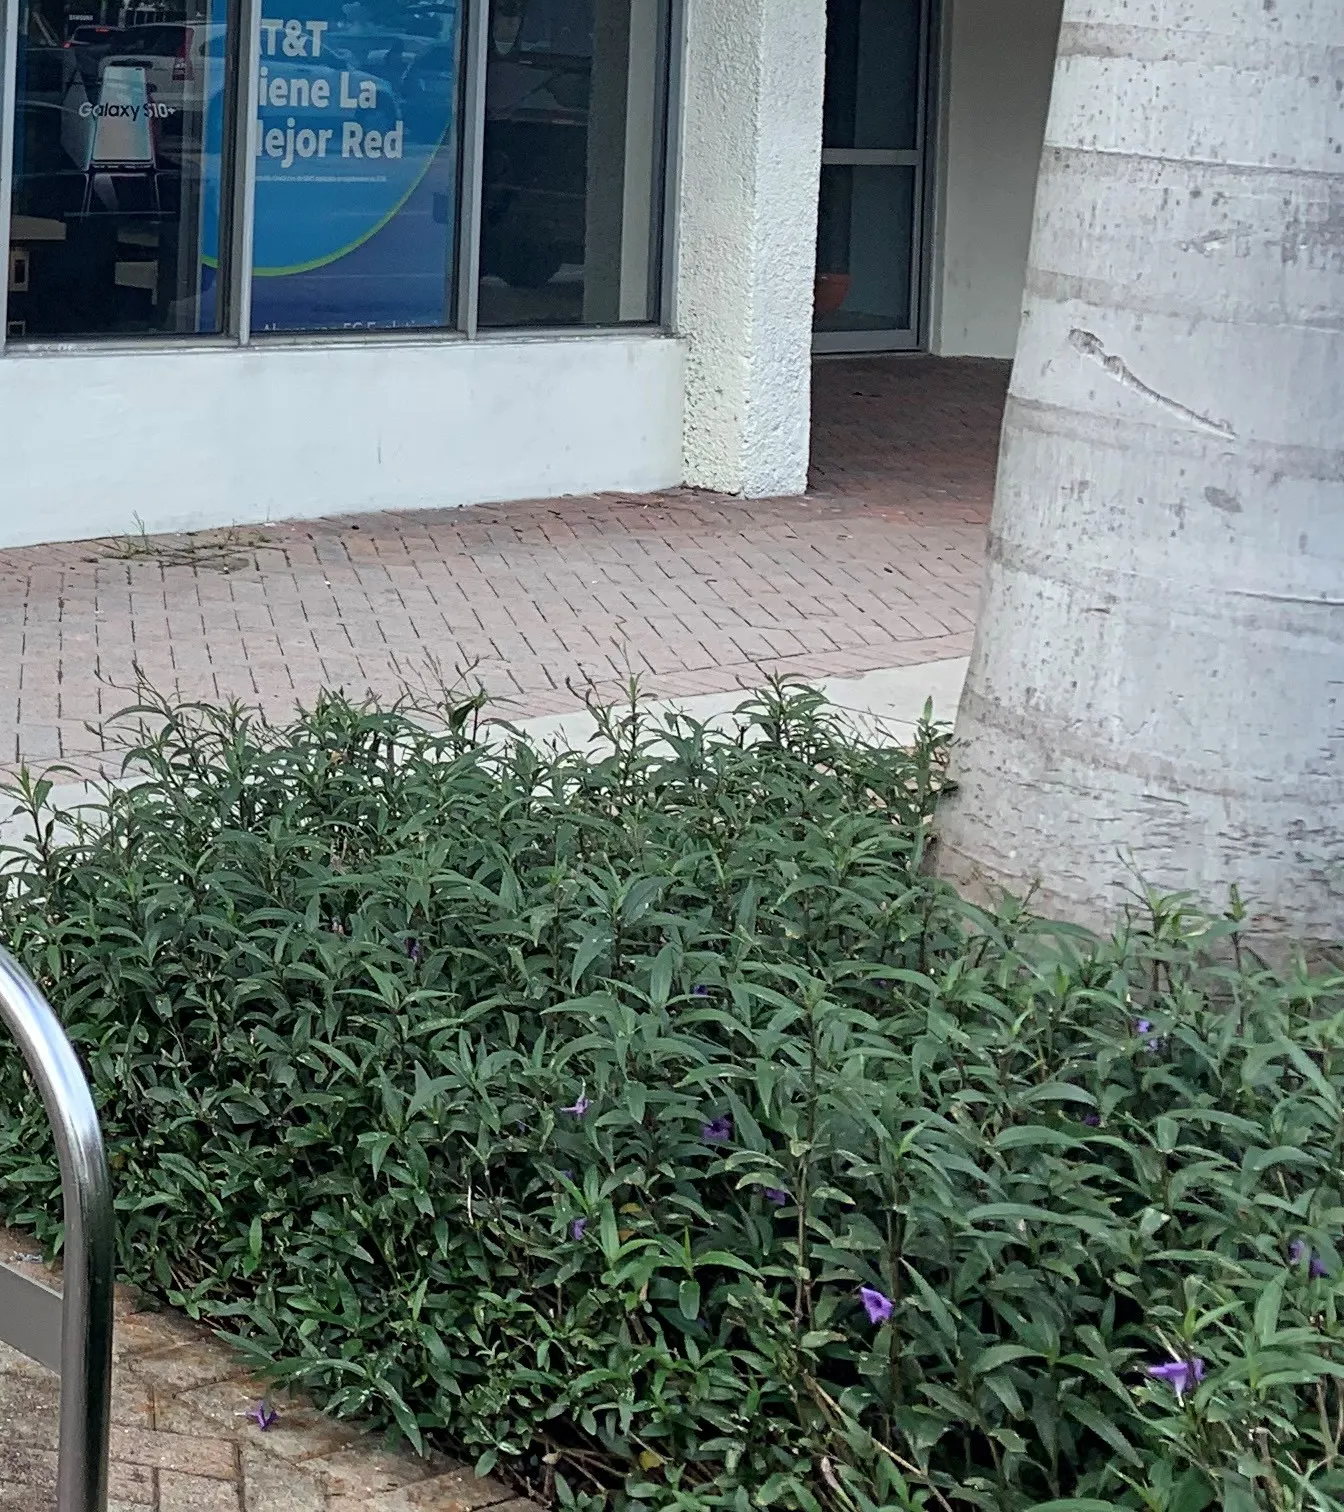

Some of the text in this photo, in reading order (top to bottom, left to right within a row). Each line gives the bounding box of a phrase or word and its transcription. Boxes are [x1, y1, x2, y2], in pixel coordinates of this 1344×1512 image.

[260, 18, 328, 58] T&T
[259, 67, 377, 109] iene La
[78, 102, 176, 121] Galaxy S10+
[255, 117, 404, 169] ejor Red
